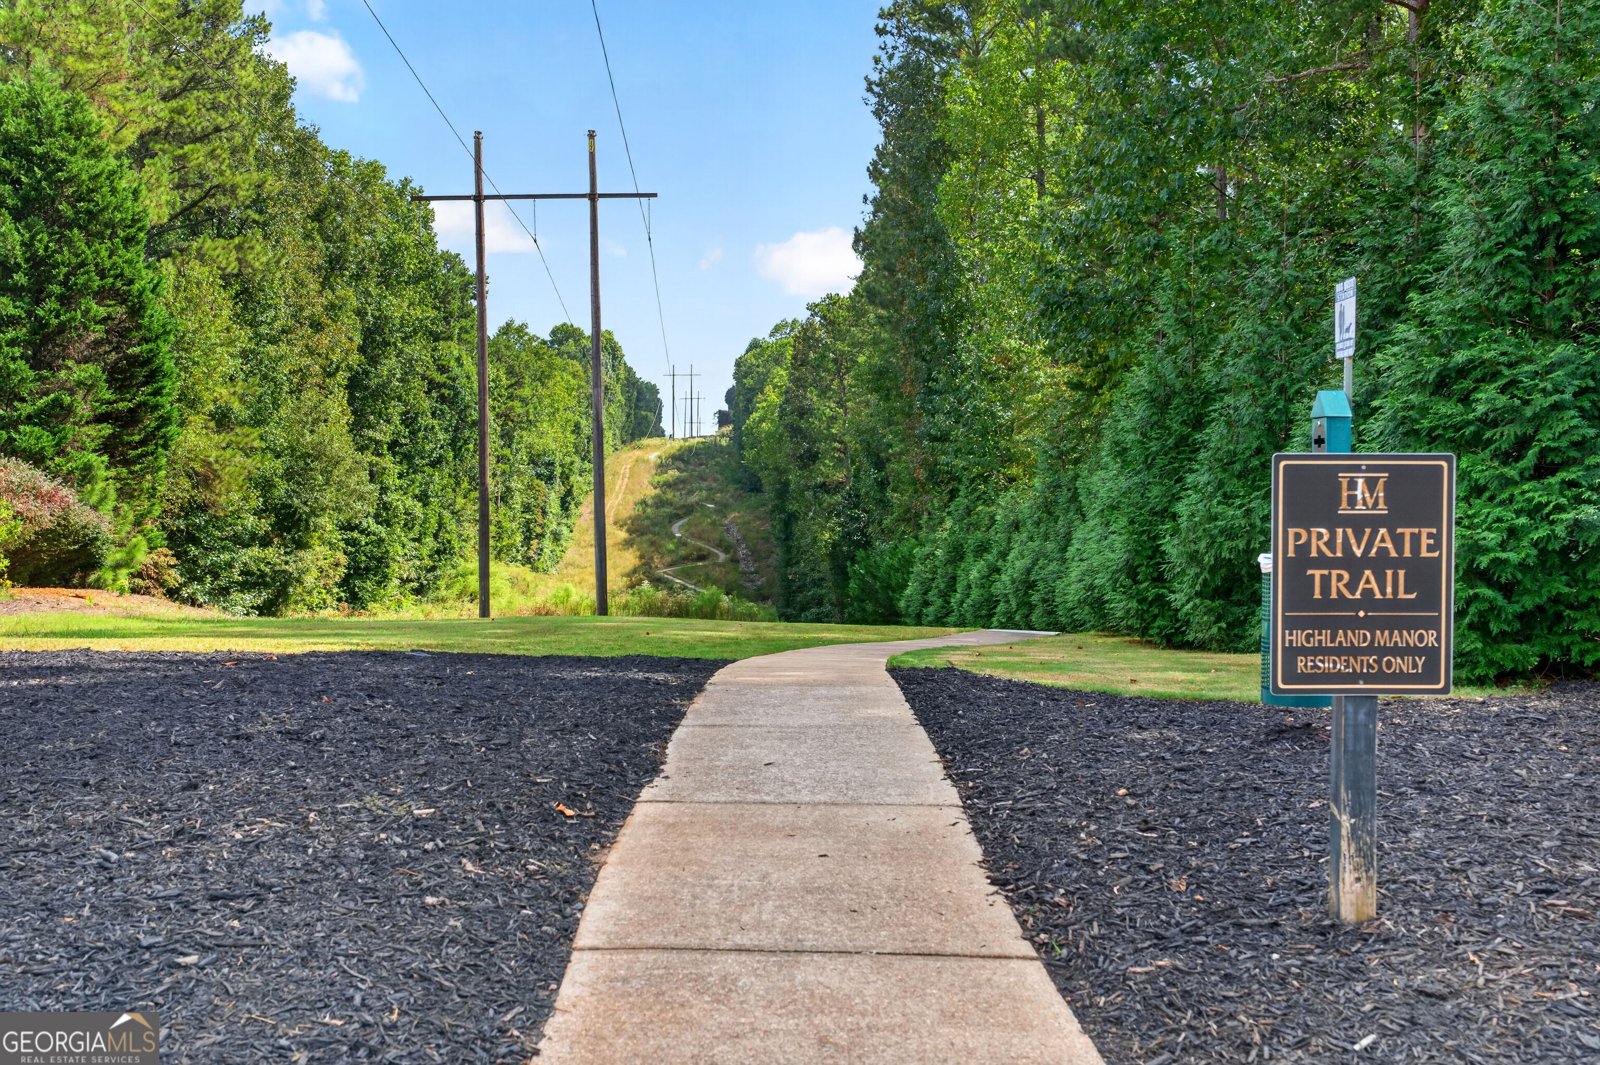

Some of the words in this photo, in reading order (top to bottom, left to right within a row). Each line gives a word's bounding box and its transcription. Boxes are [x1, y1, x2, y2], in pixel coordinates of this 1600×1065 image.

[1287, 527, 1440, 558] PRIVATE
[1306, 569, 1417, 599] TRAIL
[1285, 629, 1371, 647] HIGHLAND
[1374, 629, 1438, 647] MANOR
[1297, 655, 1378, 673] RESIDENTS
[1382, 655, 1426, 673] ONLY
